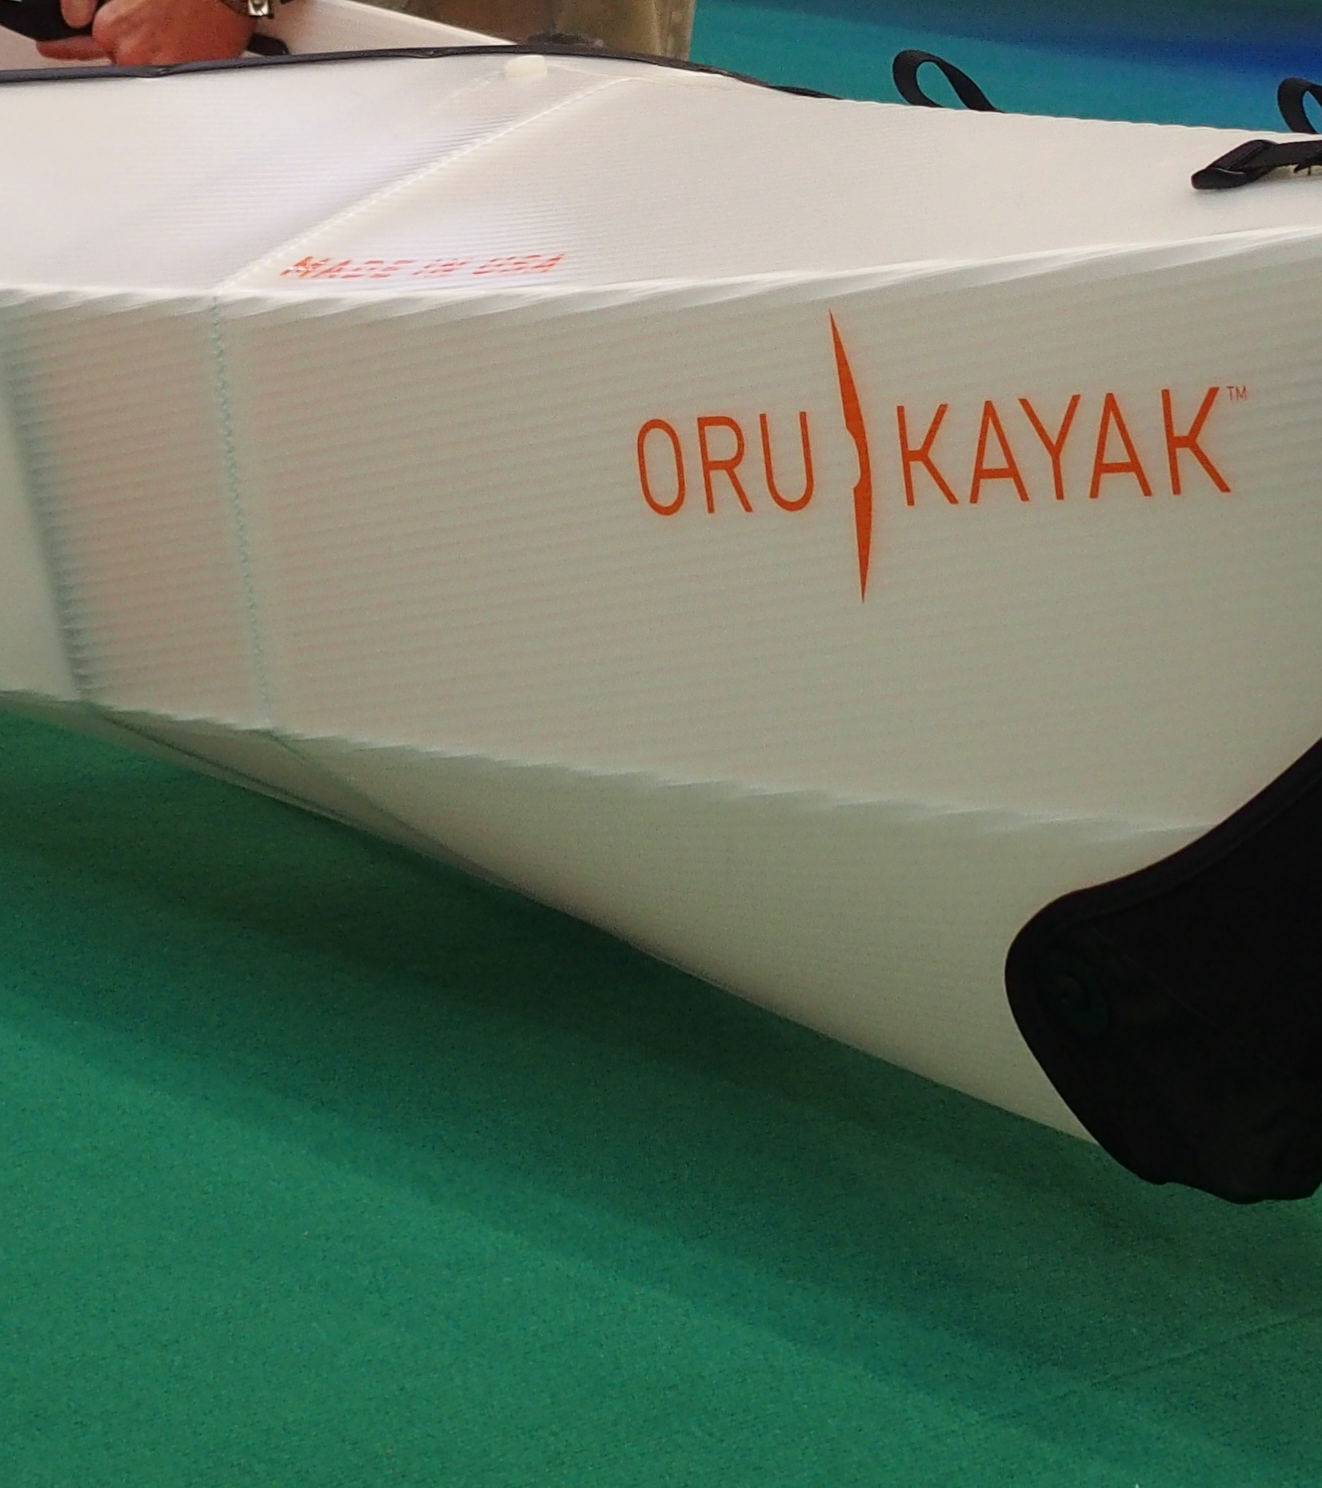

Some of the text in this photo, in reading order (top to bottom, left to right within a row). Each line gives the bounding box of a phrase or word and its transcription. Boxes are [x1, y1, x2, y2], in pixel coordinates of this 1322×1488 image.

[279, 255, 415, 279] MADE
[472, 253, 566, 275] USA
[636, 411, 815, 516] ORU
[896, 386, 1231, 507] KAYAK
